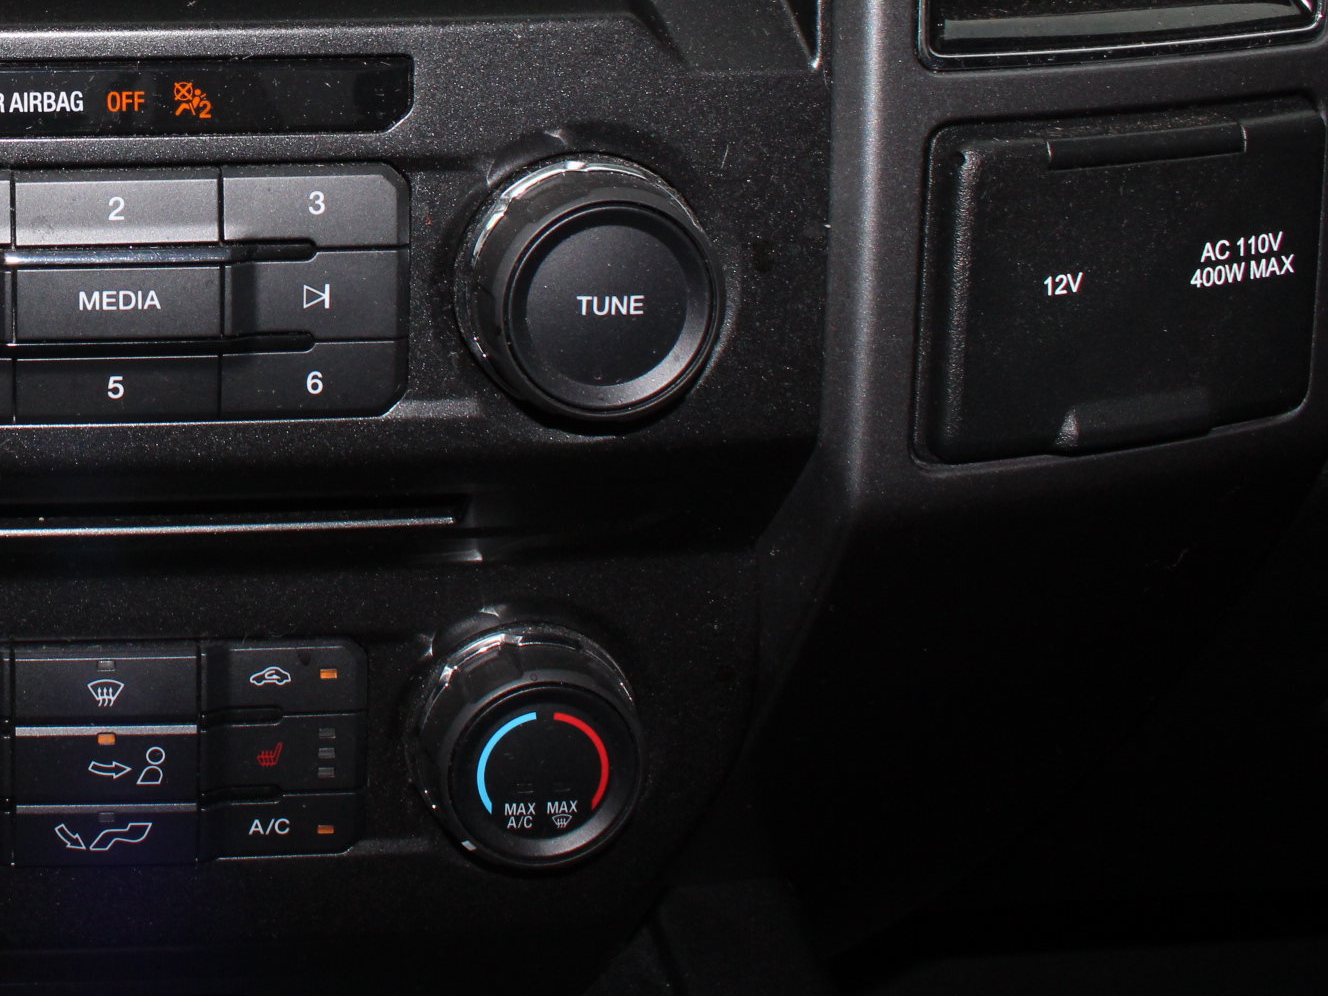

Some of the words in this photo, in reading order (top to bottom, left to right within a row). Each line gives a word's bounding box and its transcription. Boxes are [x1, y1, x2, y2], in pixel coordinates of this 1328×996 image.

[9, 90, 84, 113] AIRBAG
[106, 91, 146, 112] OFF
[108, 198, 125, 221] 2
[308, 192, 326, 215] 3
[1200, 239, 1231, 262] AC
[1236, 231, 1283, 256] 110V
[1190, 260, 1245, 289] 400W
[1249, 254, 1295, 280] MAX
[1043, 272, 1083, 296] 12V
[78, 290, 162, 311] MEDIA
[576, 295, 645, 316] TUNE
[107, 376, 125, 399] 5
[306, 371, 324, 395] 6
[504, 802, 536, 816] MAX
[546, 800, 578, 814] MAX
[248, 818, 291, 836] A/C
[507, 815, 533, 829] A/C
